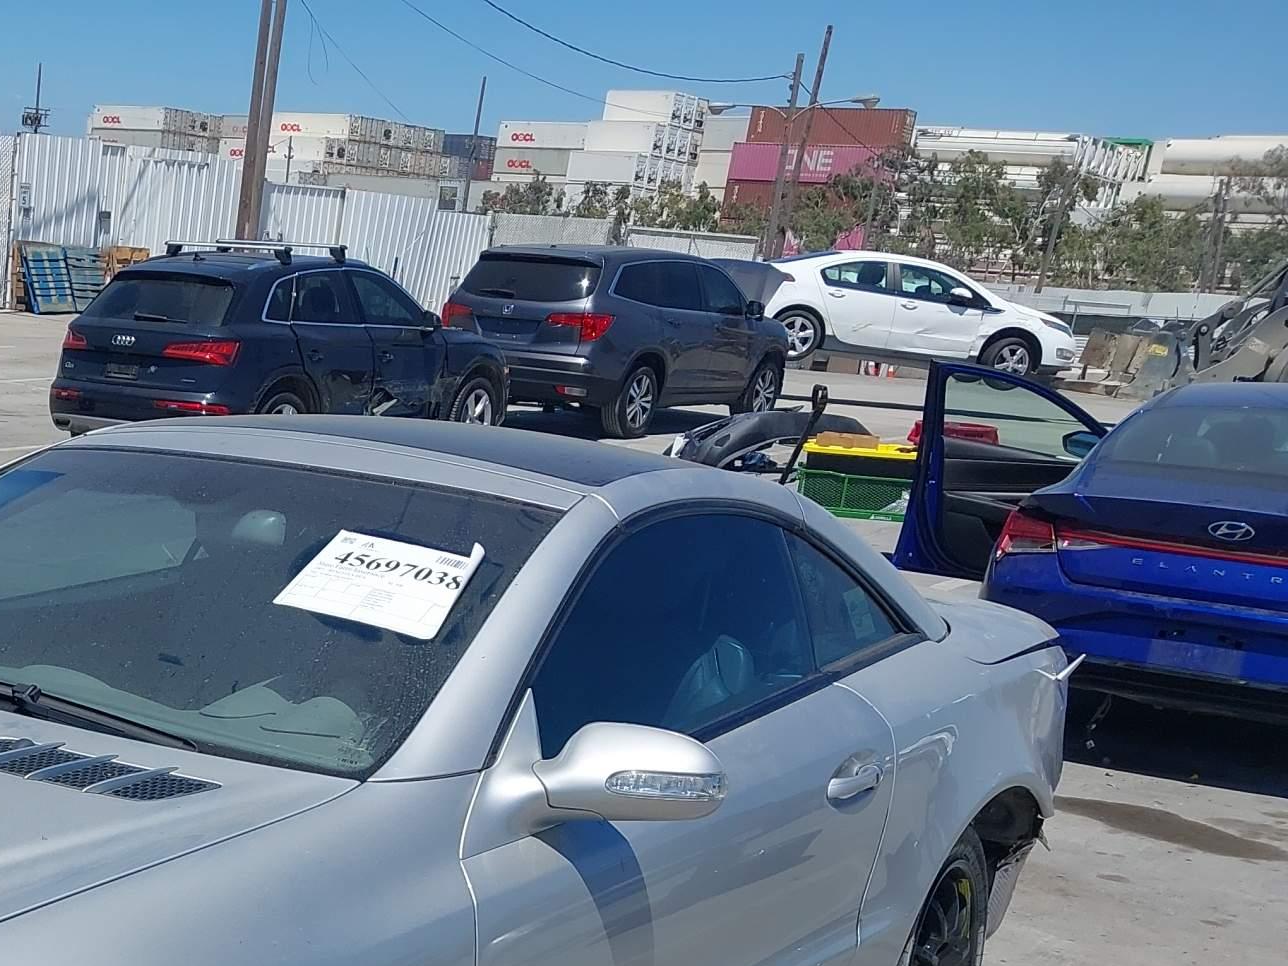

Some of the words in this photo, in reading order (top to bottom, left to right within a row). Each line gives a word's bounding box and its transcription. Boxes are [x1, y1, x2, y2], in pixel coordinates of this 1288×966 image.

[281, 123, 302, 132] OOCL
[511, 133, 535, 142] OOCL
[334, 551, 464, 590] 45697038
